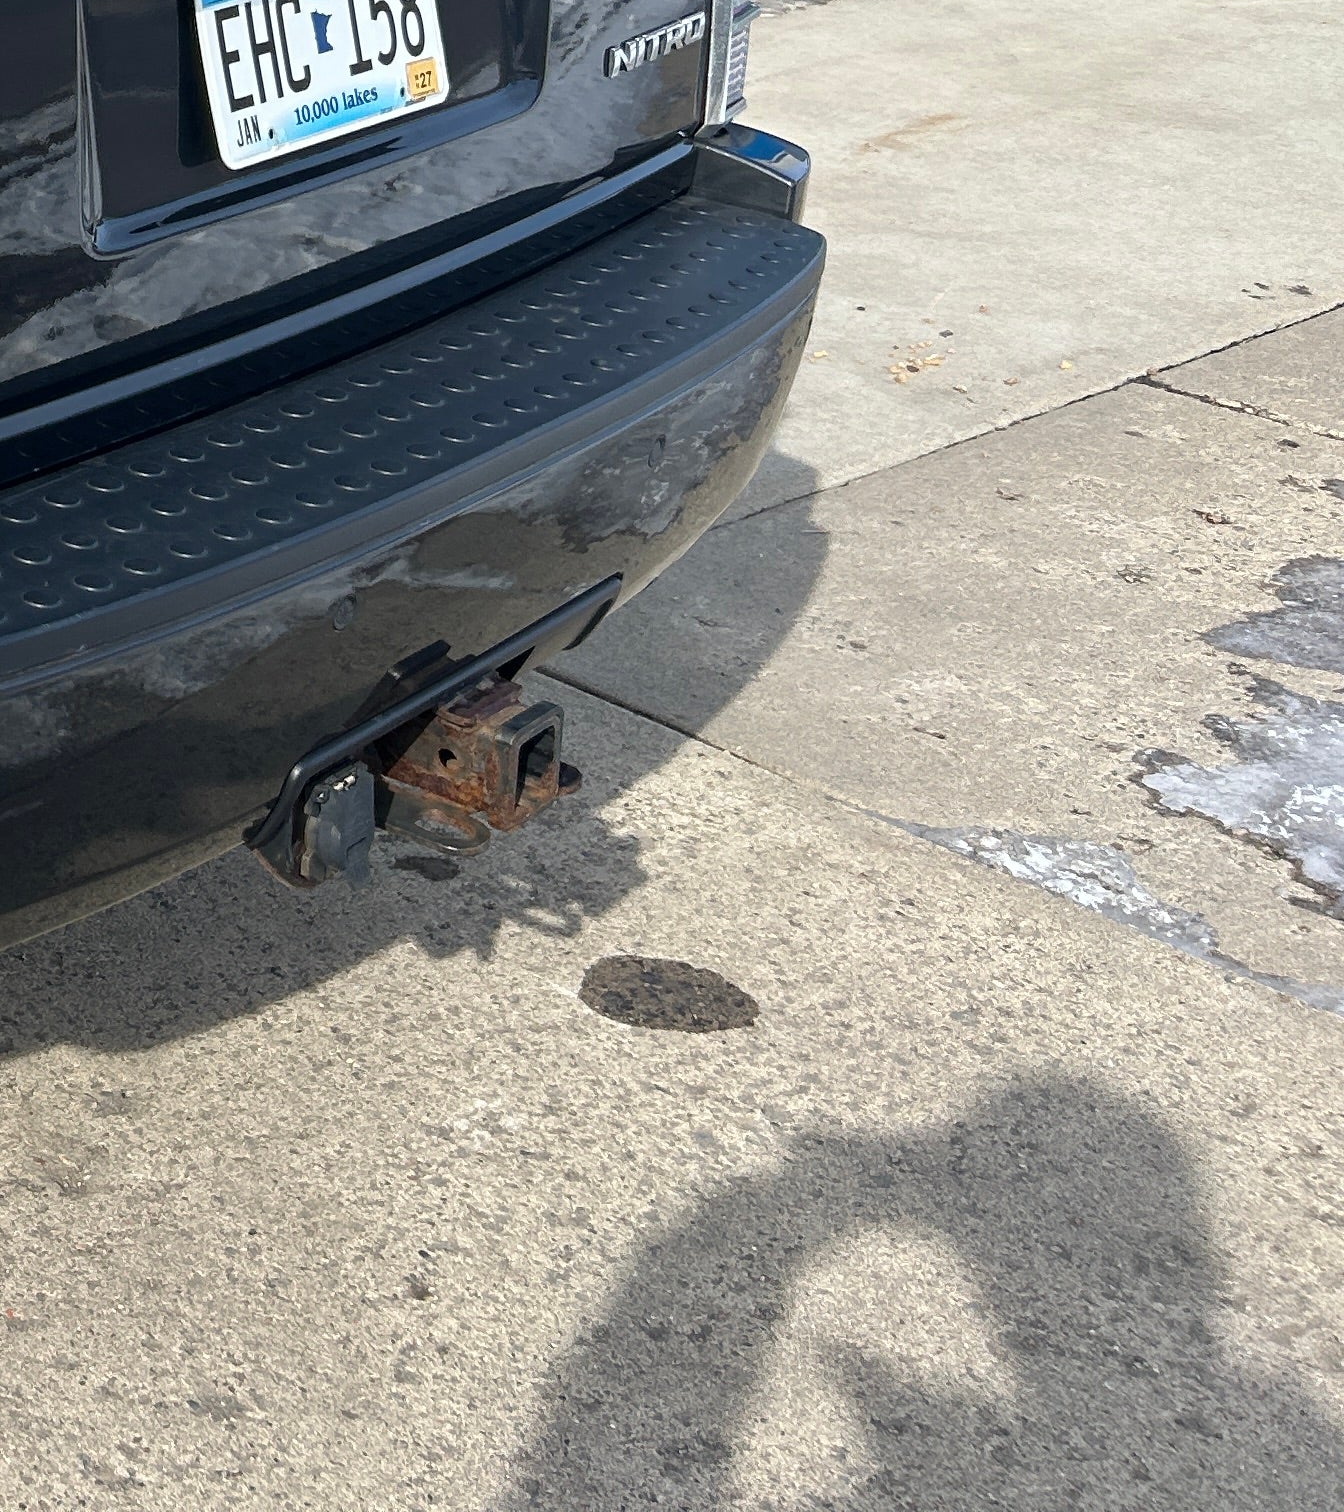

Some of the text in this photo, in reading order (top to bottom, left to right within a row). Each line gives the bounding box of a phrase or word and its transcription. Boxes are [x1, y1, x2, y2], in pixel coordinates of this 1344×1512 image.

[603, 11, 706, 80] NITRO
[419, 70, 432, 88] 27
[293, 86, 379, 126] 10,000 lakes
[237, 115, 262, 147] JAN
